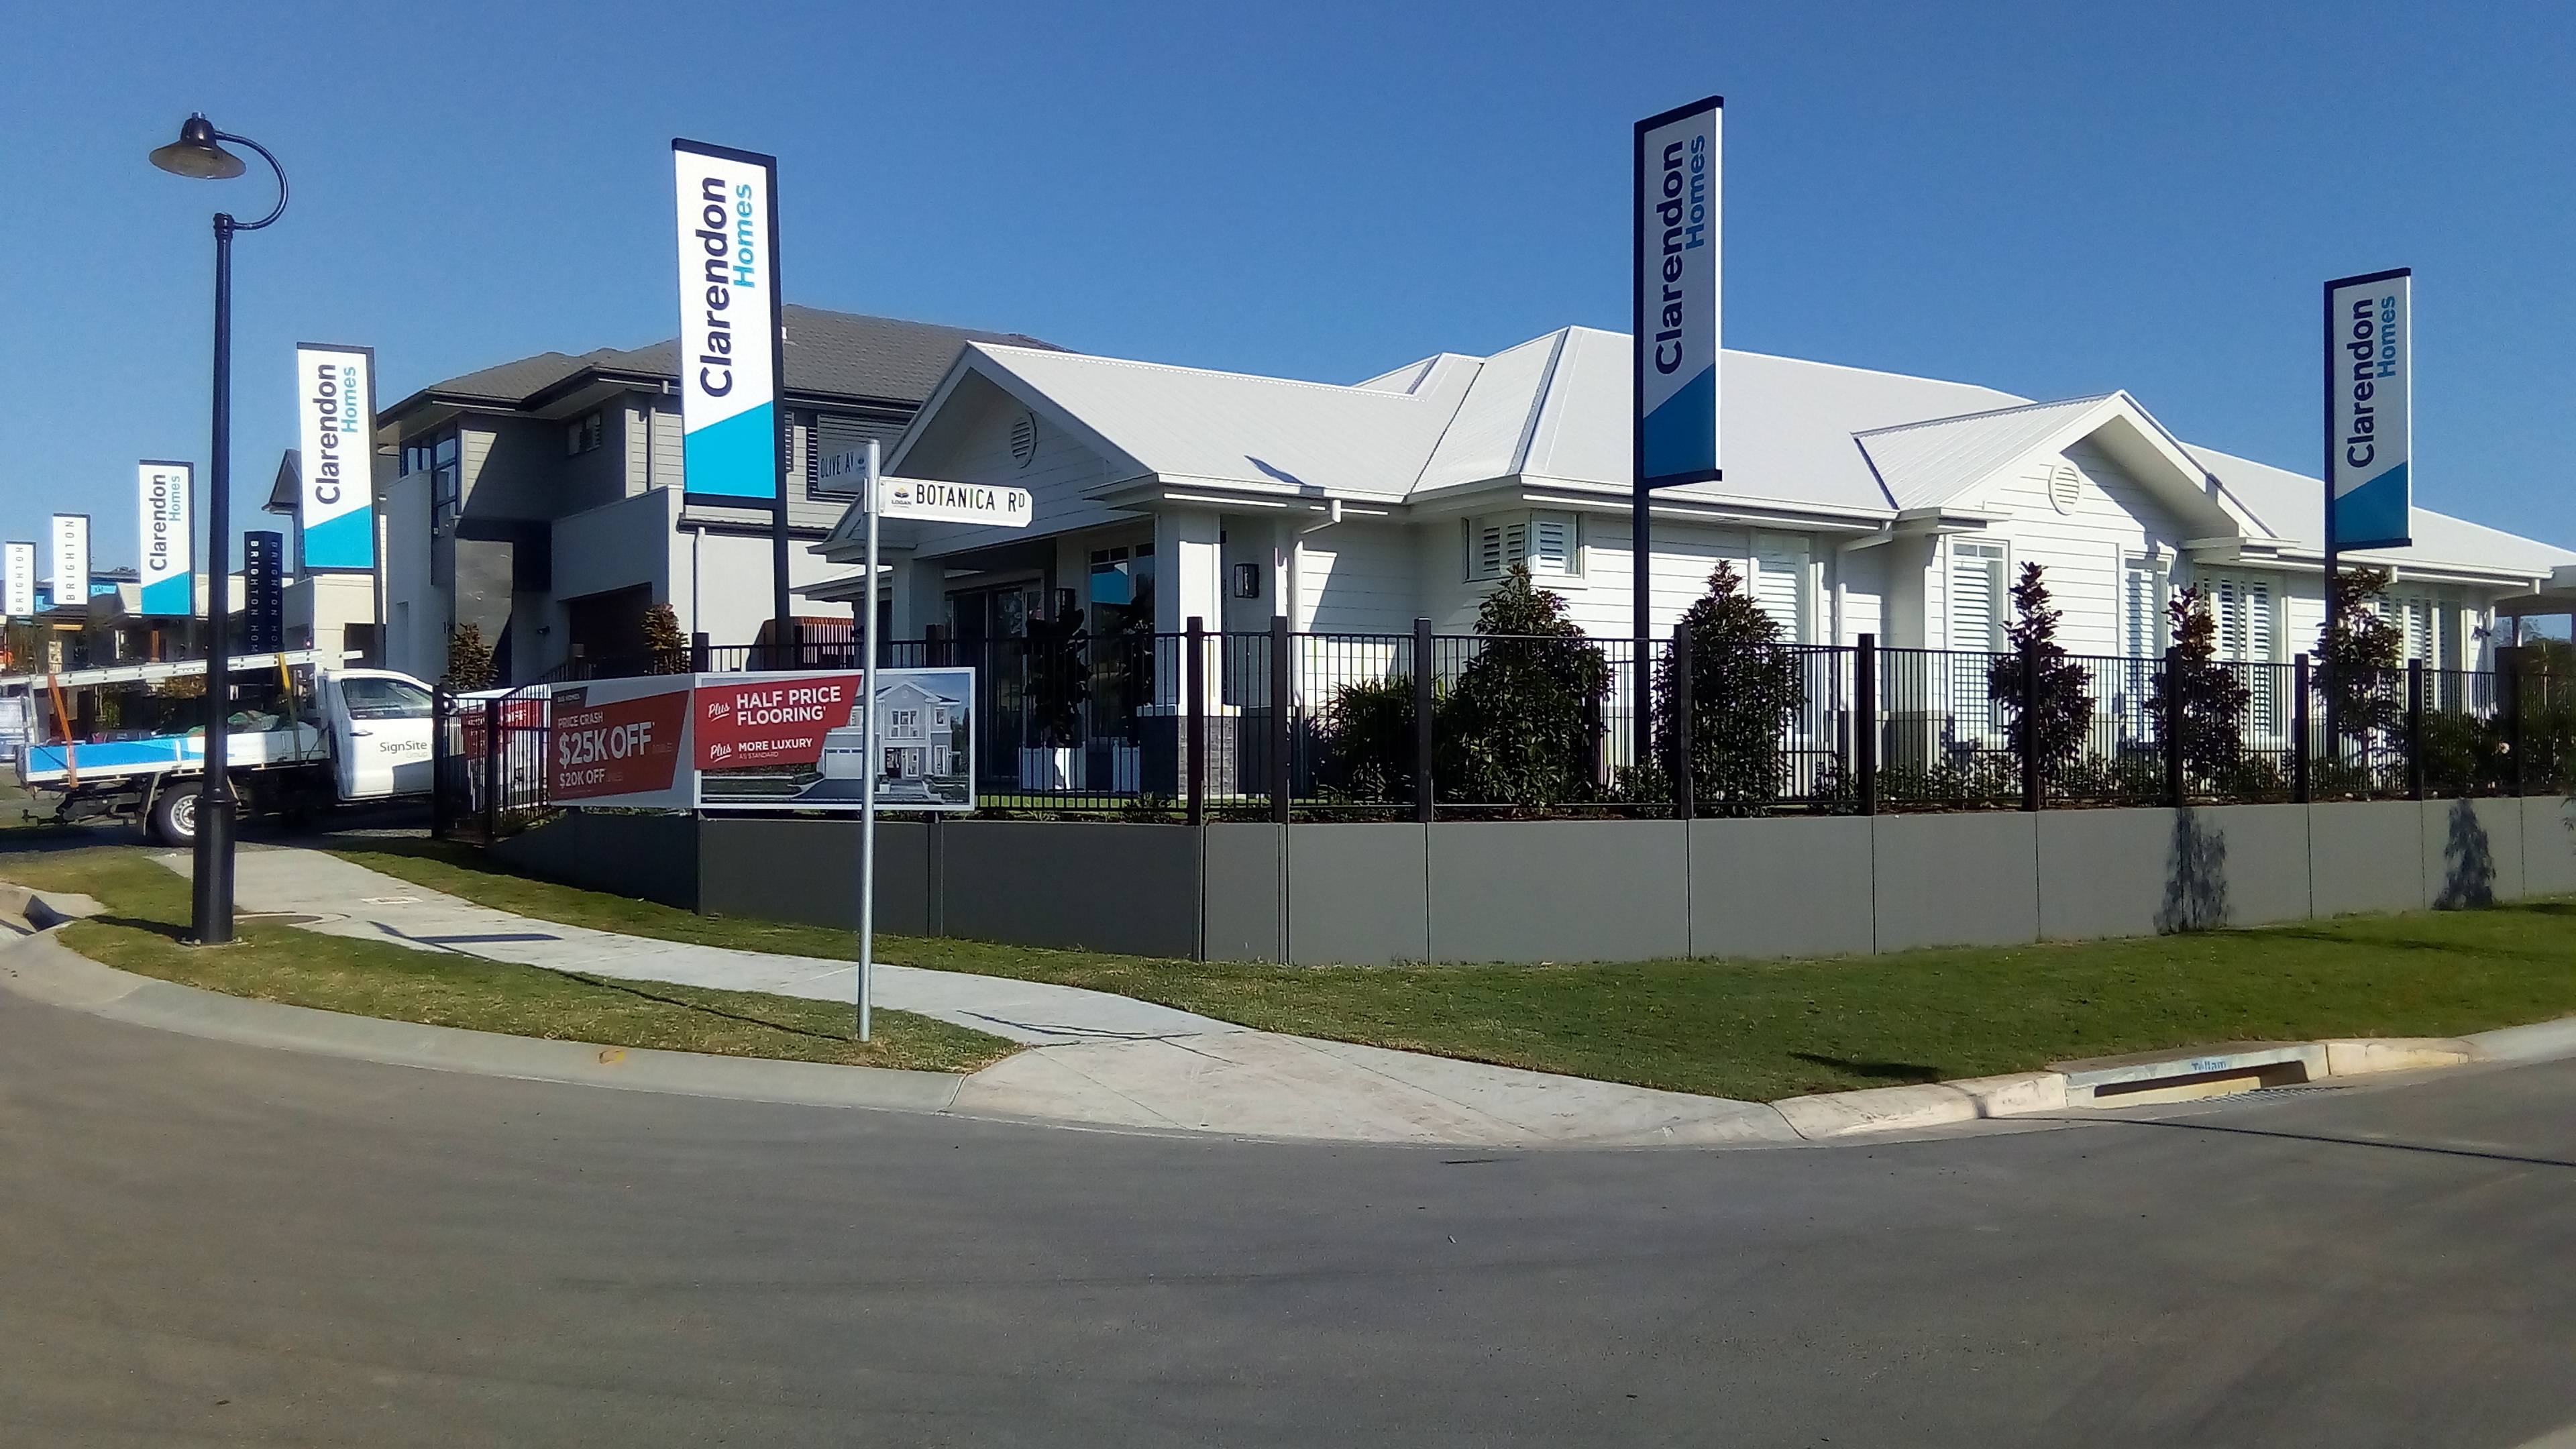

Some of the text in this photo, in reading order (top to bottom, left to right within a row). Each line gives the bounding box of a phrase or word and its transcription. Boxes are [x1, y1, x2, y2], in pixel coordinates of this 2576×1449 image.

[1686, 135, 1705, 250] Homes
[733, 183, 755, 288] Homes
[1655, 140, 1683, 375] Clarendon
[695, 176, 733, 398] Clarendon
[2377, 295, 2396, 378] Homes
[341, 366, 358, 433] Homes
[2347, 298, 2375, 468] Clarendon
[313, 364, 341, 505] Clarendon
[820, 455, 841, 478] OLIVE
[148, 474, 168, 572] Clarendon
[168, 475, 181, 521] Homes
[916, 483, 1025, 513] BOTANICA RD
[15, 547, 24, 612] BRIGHTON
[65, 521, 76, 600] BRIGHTON
[249, 541, 260, 616] BRIGHTON
[270, 541, 278, 616] BRIGHTON
[558, 711, 604, 729] PRICE CRASH
[708, 702, 731, 718] Plus
[736, 686, 842, 710] HALF PRICE
[380, 740, 427, 754] SignSite
[559, 728, 609, 769] $25K
[710, 742, 732, 759] Plus
[738, 738, 813, 752] MORE LUXURY
[748, 751, 779, 759] STANDARD
[559, 770, 584, 789] $20K
